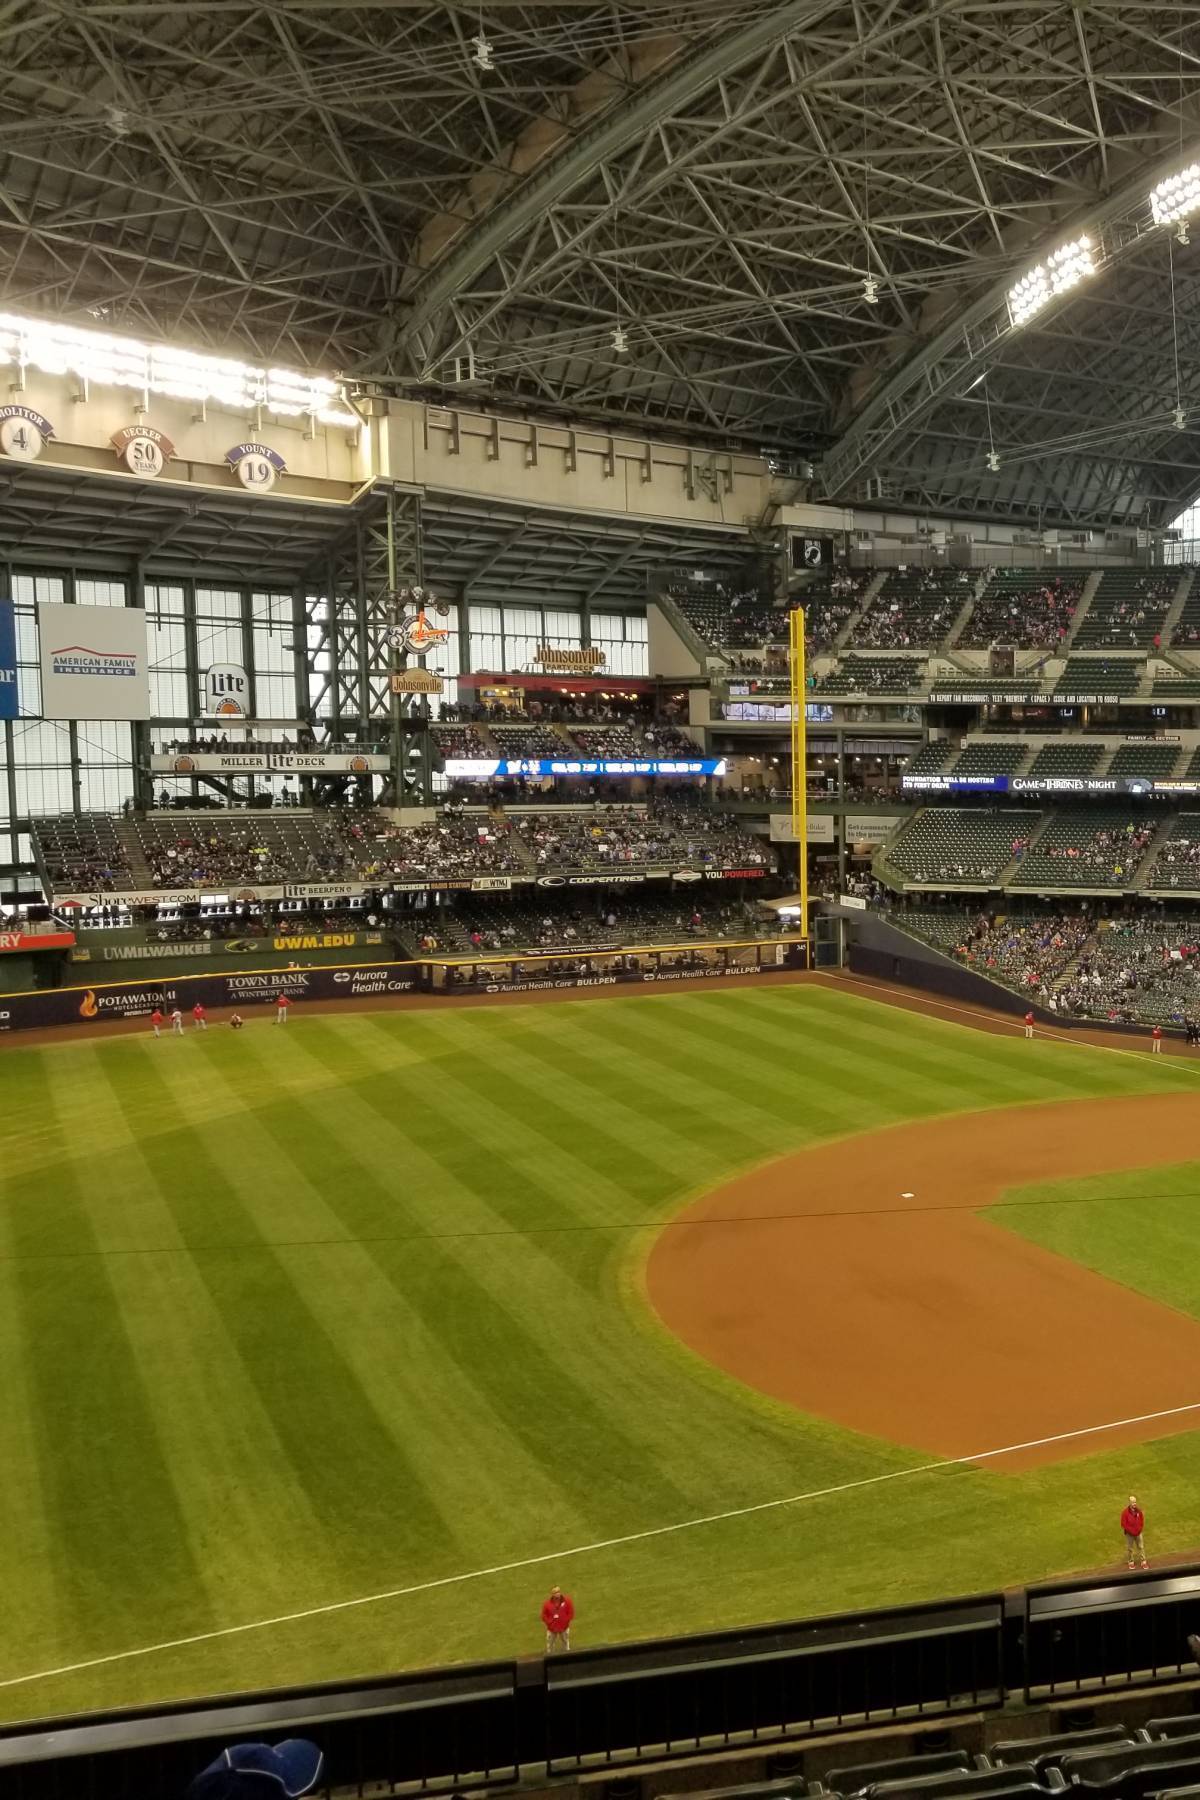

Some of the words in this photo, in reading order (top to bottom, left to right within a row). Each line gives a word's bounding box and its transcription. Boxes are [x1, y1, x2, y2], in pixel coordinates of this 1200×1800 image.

[12, 427, 27, 450] 4
[122, 427, 162, 442] UECKER
[133, 442, 155, 463] 50
[239, 443, 273, 458] YOUNT
[244, 461, 270, 483] 19
[53, 657, 101, 666] AMERICAN
[103, 658, 136, 667] FAMILY
[533, 644, 607, 665] Johnsonville
[59, 667, 131, 675] INSURANCE
[211, 673, 244, 697] Lite
[393, 678, 442, 692] Johnsonville
[221, 757, 264, 766] MILLER
[265, 754, 294, 771] Lite
[296, 757, 326, 766] DECK
[1013, 778, 1040, 789] GAME
[1044, 779, 1084, 790] THRONES
[1088, 780, 1117, 789] NIGHT
[705, 871, 724, 879] YOU.
[724, 869, 767, 879] POWERED.
[273, 934, 356, 950] UWM.EDU
[226, 975, 268, 988] TOWN
[271, 973, 310, 986] BANK
[352, 970, 388, 981] Aurora
[657, 972, 680, 980] Aurora
[681, 969, 705, 978] Health
[705, 969, 721, 977] Care
[725, 966, 761, 975] BULLPEN
[351, 981, 386, 993] Health
[387, 980, 412, 991] Care
[501, 983, 527, 992] Aurora
[528, 979, 554, 990] Health
[554, 980, 572, 988] Care
[577, 977, 616, 987] BULLPEN
[98, 990, 176, 1007] POTAWATOMI
